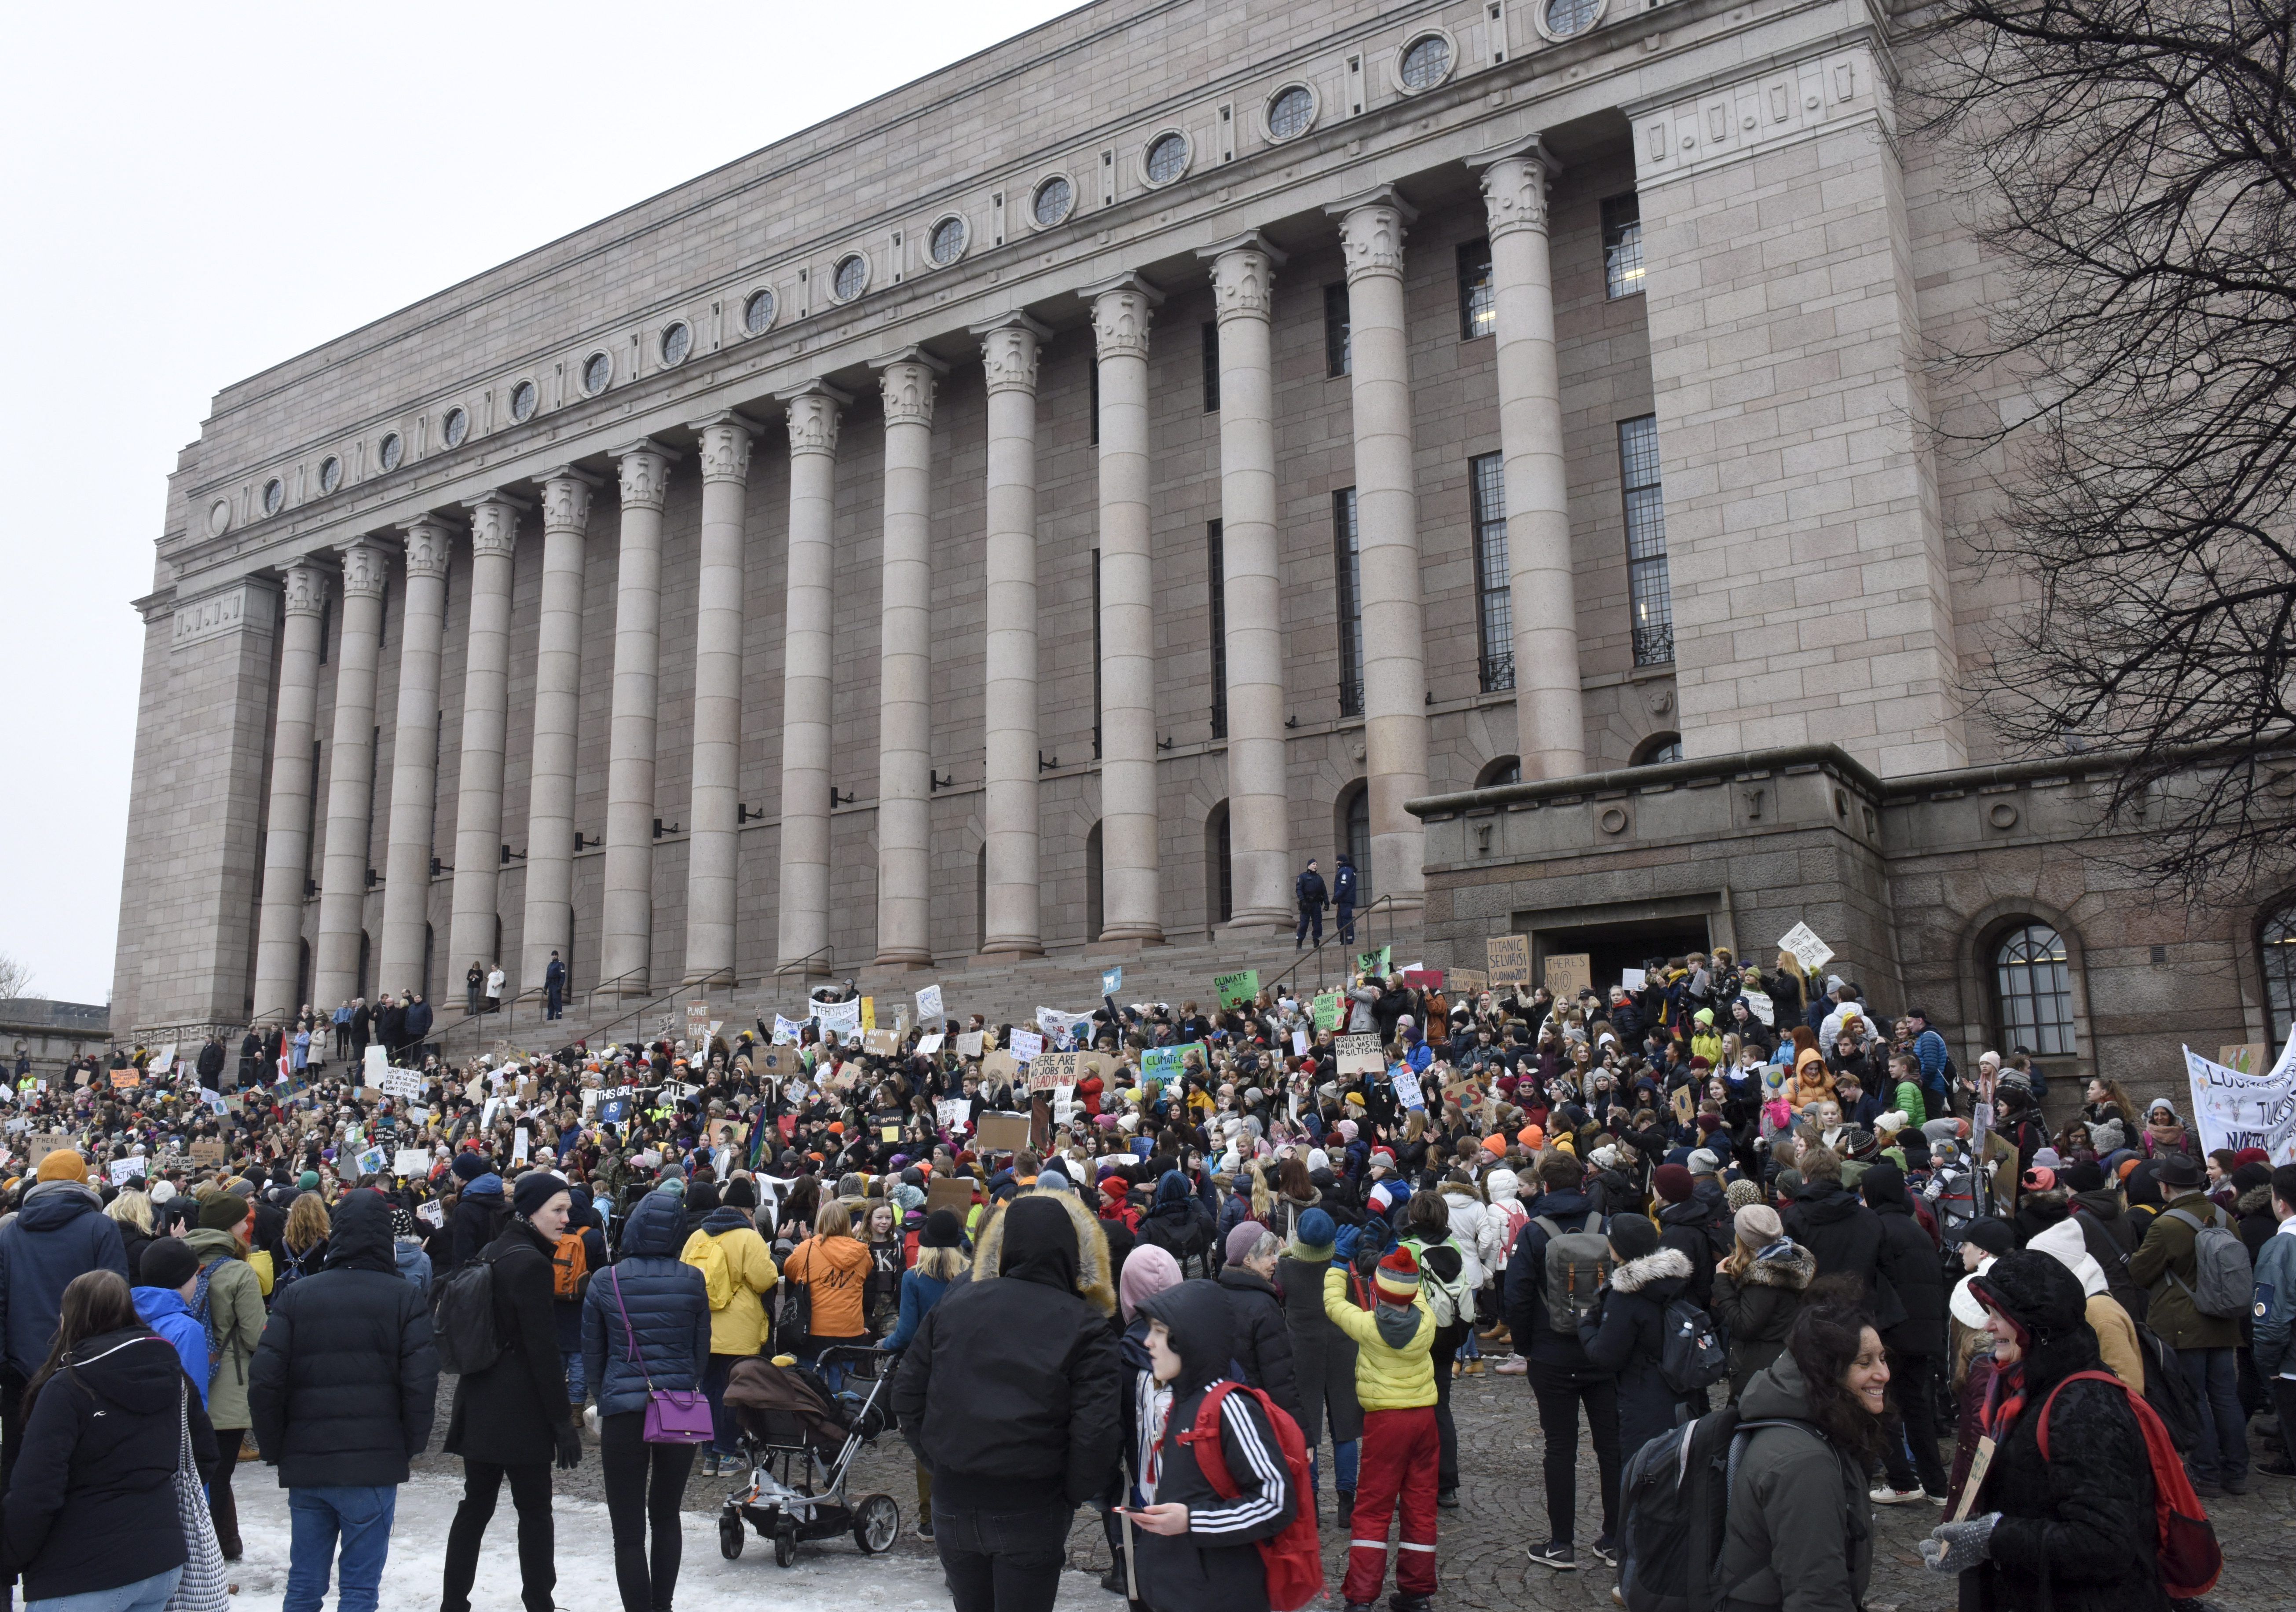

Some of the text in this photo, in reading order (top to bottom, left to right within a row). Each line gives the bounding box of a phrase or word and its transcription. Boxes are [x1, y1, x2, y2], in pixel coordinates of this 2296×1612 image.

[1488, 939, 1523, 954] TITANIC
[1789, 937, 1816, 966] GRETA
[1362, 950, 1381, 967] SAVE
[1489, 953, 1527, 968] SELVIÄISI
[1546, 956, 1585, 970] THERE'S
[1214, 972, 1248, 987] CLIMATE
[1547, 971, 1571, 993] NO
[1315, 996, 1335, 1006] CLIMATE
[688, 1006, 708, 1016] PLANET
[1316, 1004, 1335, 1014] CHANGE
[1043, 1012, 1058, 1023] THERE
[1315, 1014, 1334, 1024] SYSTEM
[688, 1024, 707, 1036] FUTURE
[1030, 1055, 1077, 1070] THERE ARE
[1146, 1055, 1177, 1065] CLIMATE
[1031, 1066, 1074, 1078] NO JOBS ON
[1033, 1076, 1051, 1090] DEAD
[1393, 1074, 1415, 1088] SAVE
[1398, 1082, 1417, 1093] OUR
[597, 1085, 632, 1101] THIS GIRL
[1402, 1091, 1421, 1104] PLANET
[609, 1102, 618, 1112] IS
[2226, 1131, 2268, 1152] NUORTEN
[114, 1171, 126, 1180] ACT
